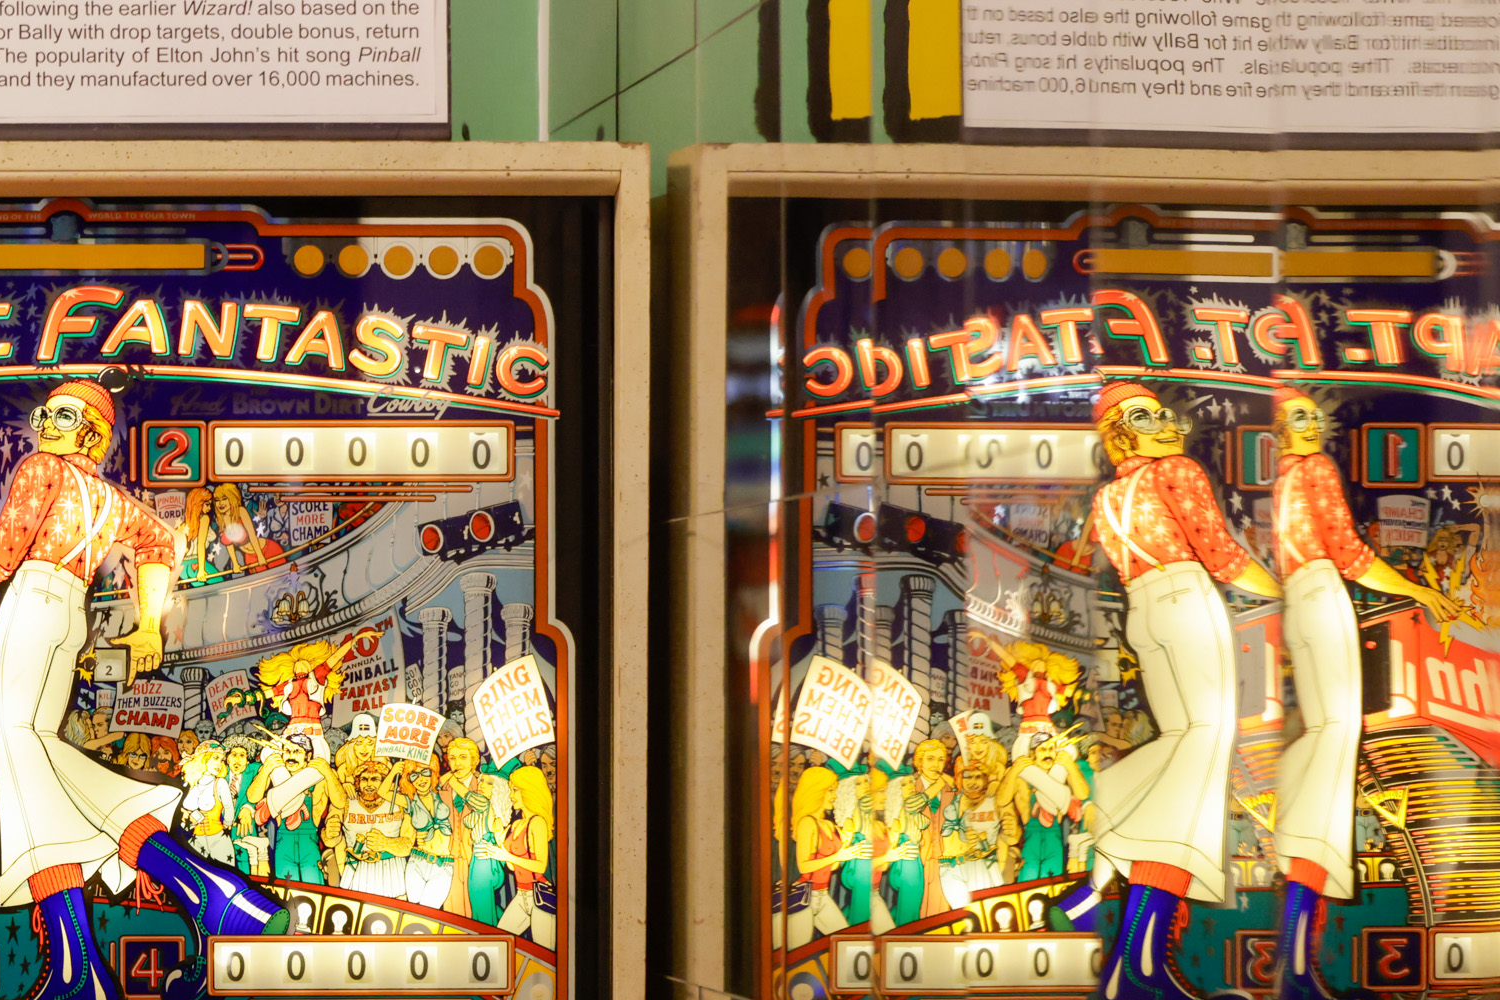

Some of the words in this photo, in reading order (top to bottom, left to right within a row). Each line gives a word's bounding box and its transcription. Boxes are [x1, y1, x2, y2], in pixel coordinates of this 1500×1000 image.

[0, 1, 78, 20] following
[85, 1, 113, 16] the
[119, 1, 176, 16] earlier
[184, 0, 253, 15] Wizard!
[258, 0, 295, 15] also
[302, 0, 356, 15] based
[363, 4, 384, 15] on
[391, 0, 419, 15] the
[19, 24, 62, 43] Bally
[68, 24, 104, 39] with
[110, 24, 151, 43] drop
[157, 25, 224, 43] targets,
[231, 24, 292, 39] double
[299, 24, 359, 40] bonus,
[367, 24, 418, 38] return
[36, 48, 124, 67] popularity
[132, 47, 149, 63] of
[157, 47, 202, 63] Elton
[211, 47, 270, 62] John’s
[278, 47, 299, 62] hit
[306, 51, 350, 66] song
[359, 47, 421, 62] Pinball
[37, 72, 75, 90] they
[81, 71, 206, 86] manufactured
[212, 75, 252, 86] over
[259, 71, 320, 87] 16,000
[326, 71, 418, 86] machines.
[37, 284, 550, 398] FANTASTIC
[155, 430, 193, 477] 2
[157, 496, 186, 506] PINBALL
[292, 500, 329, 516] SCORE
[158, 508, 185, 520] LORD!
[296, 513, 325, 526] MORE
[291, 525, 329, 542] CHAMP
[341, 658, 399, 686] PINBALL
[133, 683, 163, 696] BUZZ
[208, 674, 244, 698] DEATH
[340, 675, 398, 701] FANTASY
[478, 664, 532, 718] RING
[117, 697, 141, 709] THEM
[143, 697, 183, 710] BUZZERS
[352, 695, 386, 712] BALL
[485, 687, 543, 734] THEM
[115, 709, 179, 731] CHAMP
[383, 707, 439, 731] SCORE
[384, 726, 431, 745] MORE
[492, 710, 551, 762] BELLS
[376, 744, 406, 755] PINBALL
[407, 747, 430, 761] KING
[347, 811, 402, 824] BRUTUS
[130, 948, 165, 989] 4
